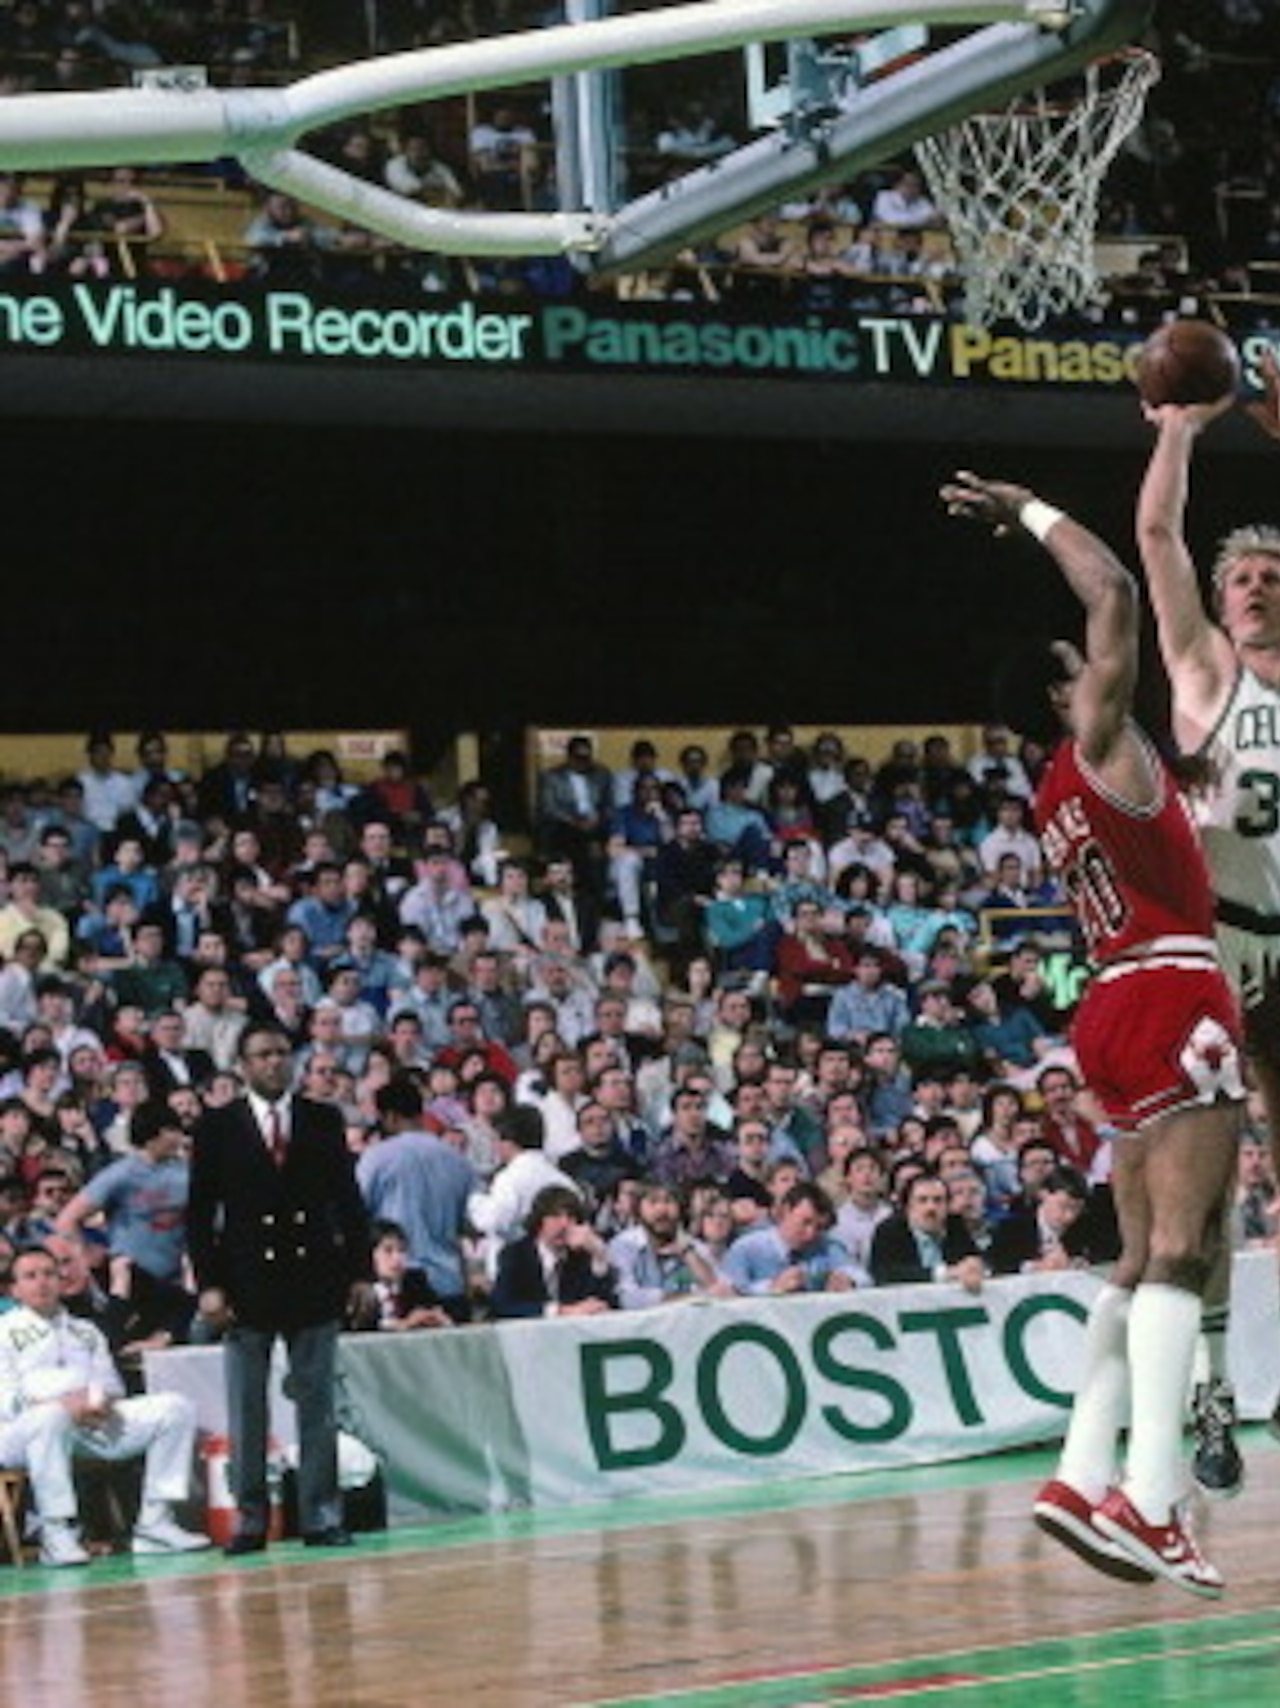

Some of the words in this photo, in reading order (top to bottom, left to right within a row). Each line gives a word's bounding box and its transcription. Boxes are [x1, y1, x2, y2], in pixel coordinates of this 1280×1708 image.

[74, 285, 251, 349] Video
[266, 293, 532, 359] Recorder
[543, 306, 858, 373] Panasonic
[859, 318, 942, 376] TV
